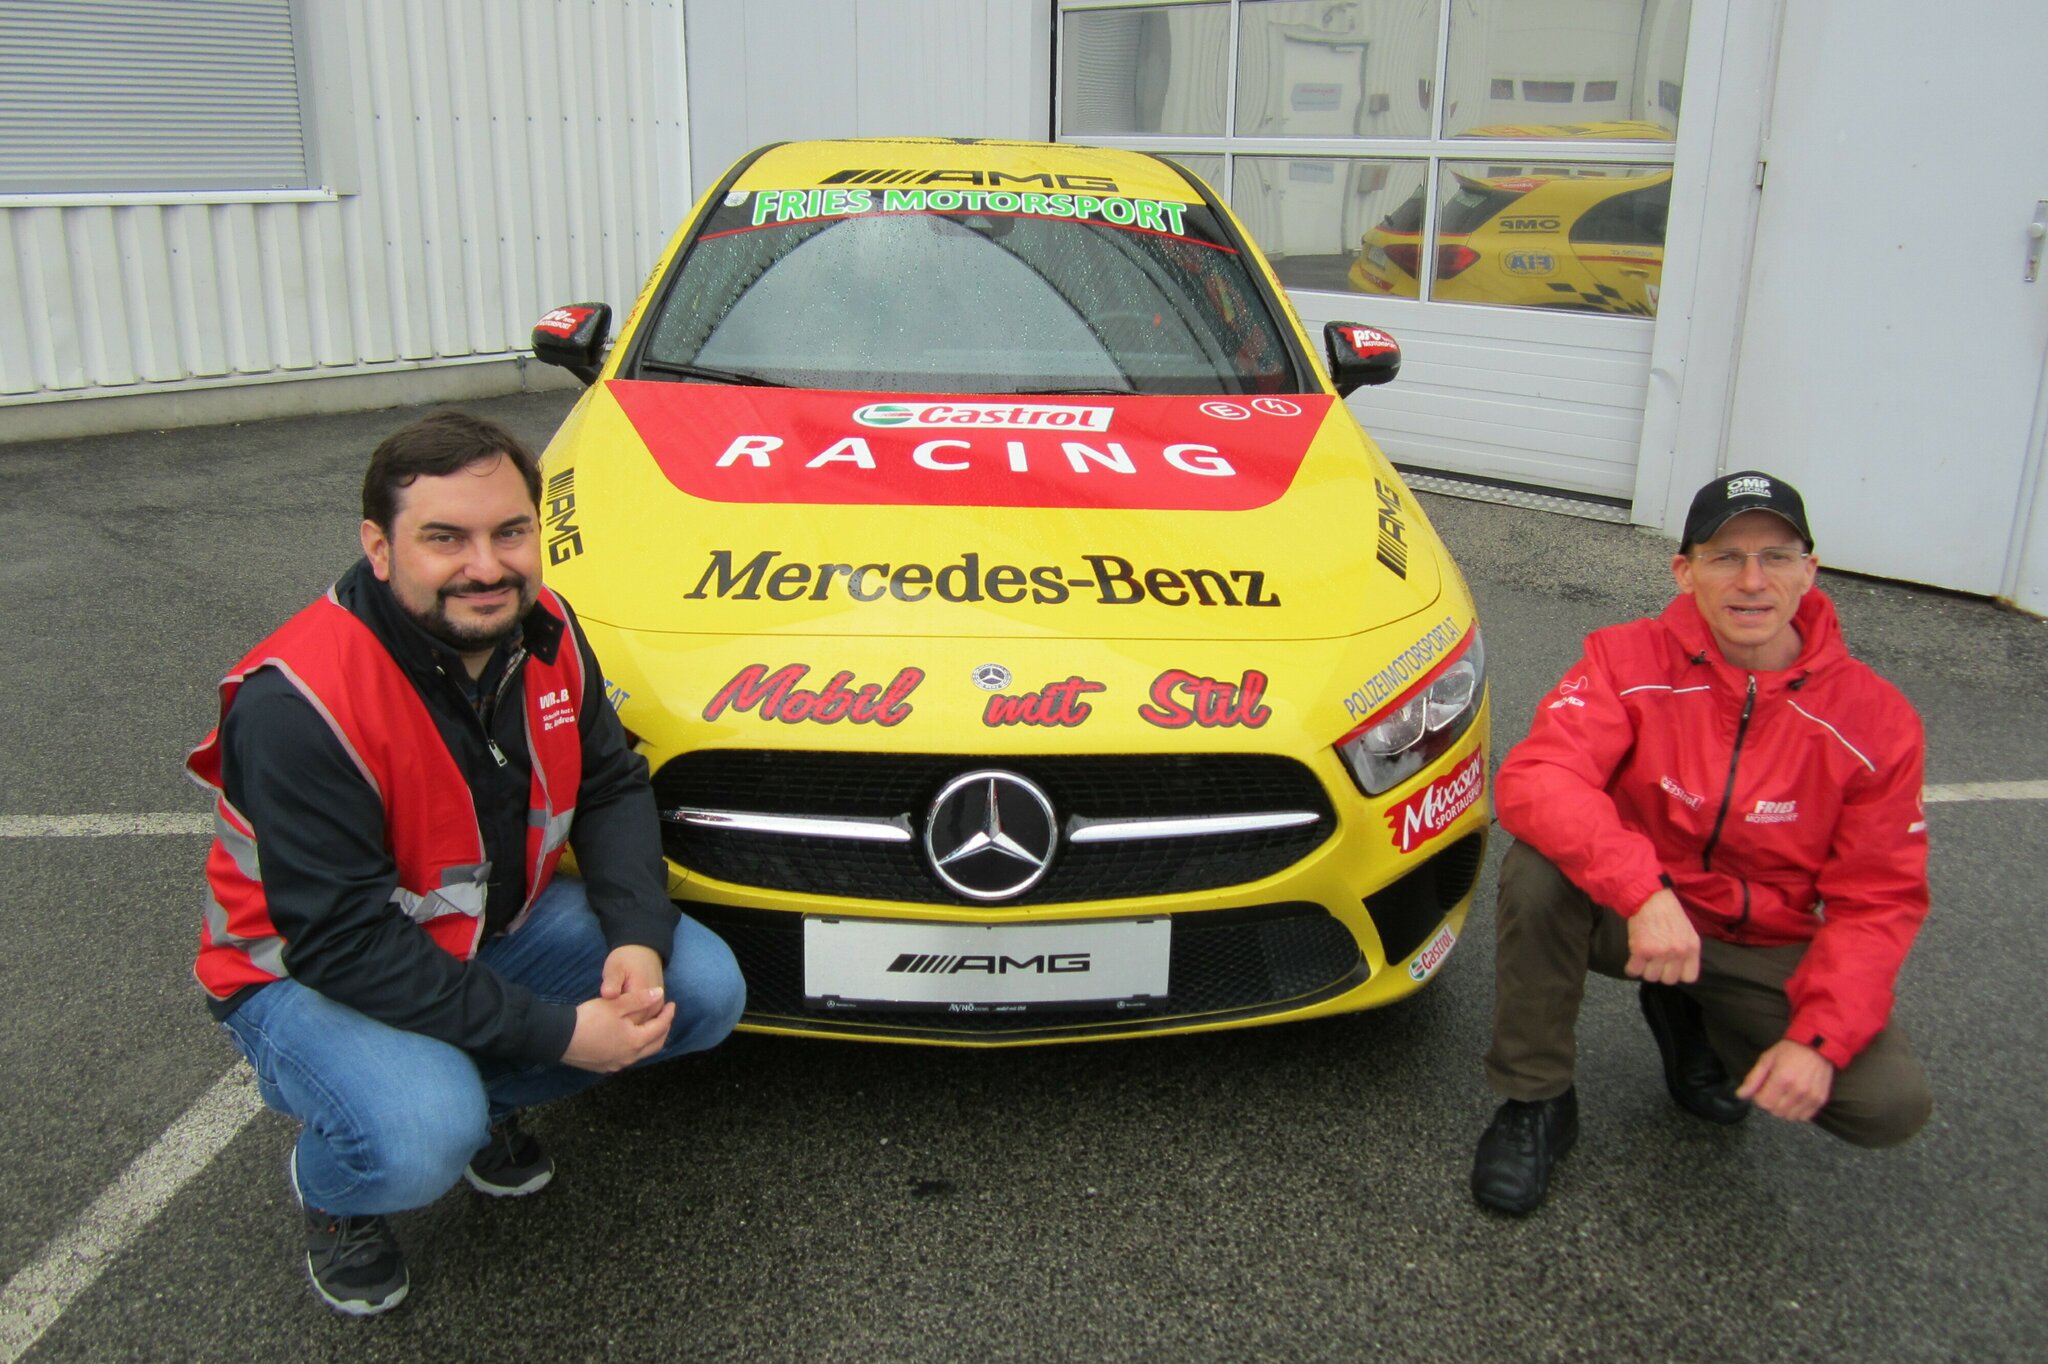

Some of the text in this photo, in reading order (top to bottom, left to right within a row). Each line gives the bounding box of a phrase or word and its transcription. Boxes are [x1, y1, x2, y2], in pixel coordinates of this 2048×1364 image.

[752, 190, 1188, 236] FRIES MOTORSPORT
[917, 405, 1097, 428] Castrol
[715, 436, 1238, 477] RACING
[1727, 478, 1771, 490] OMP
[683, 549, 1283, 607] Mercedes-Benz
[702, 663, 927, 728] Mobil
[982, 675, 1107, 728] mit
[1137, 668, 1273, 730] Stil
[948, 952, 1091, 974] AMG
[1421, 930, 1454, 970] Castrol
